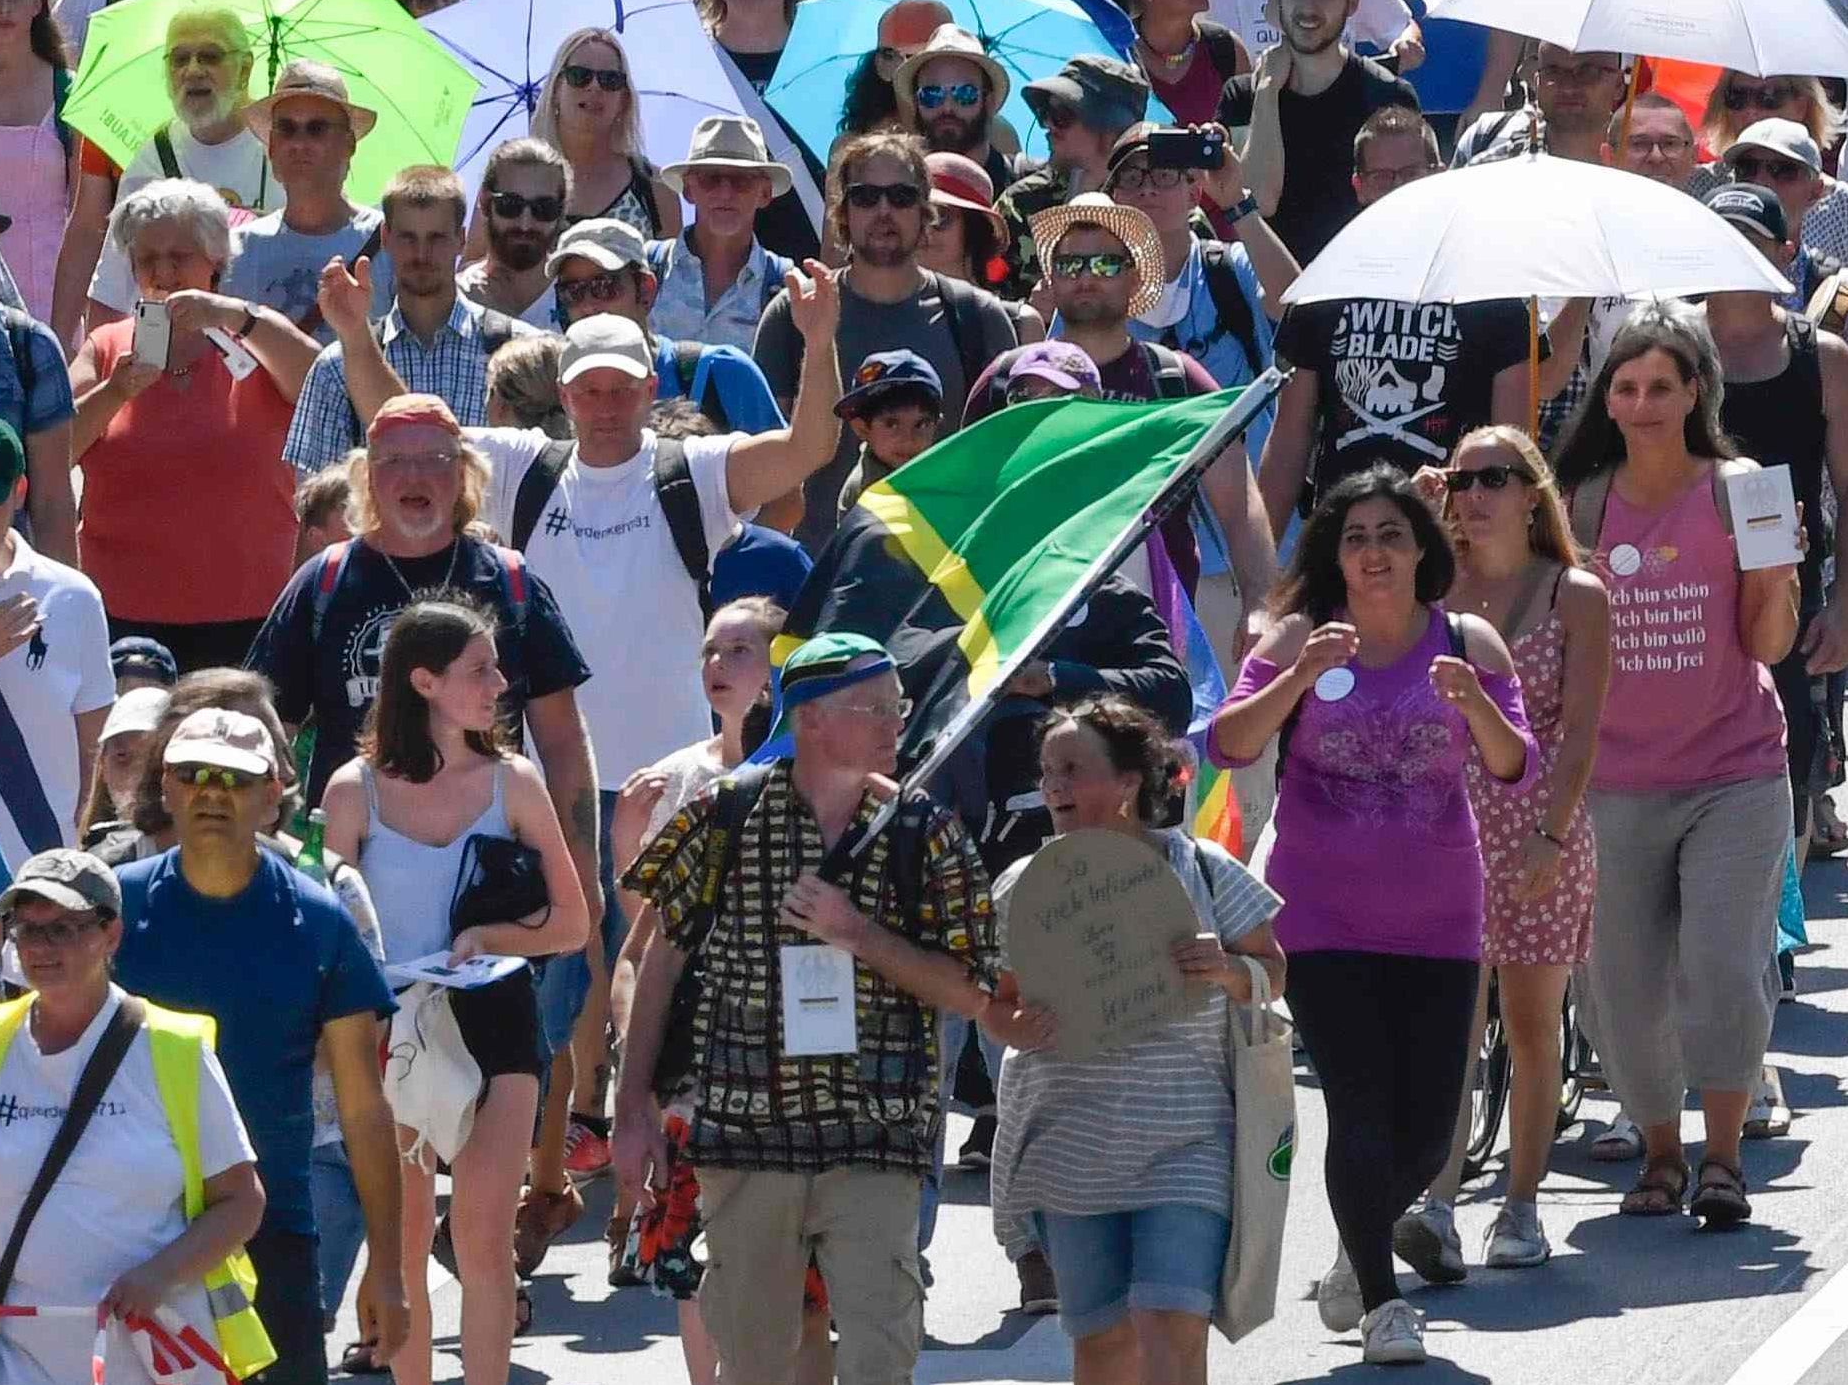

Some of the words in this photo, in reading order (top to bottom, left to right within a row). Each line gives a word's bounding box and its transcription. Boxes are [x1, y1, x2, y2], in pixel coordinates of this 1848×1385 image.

[1347, 332, 1436, 362] BLADE
[1606, 588, 1630, 605] Ich
[1634, 587, 1660, 604] bin
[1664, 581, 1709, 600] schön
[1611, 610, 1640, 628] Ich
[1645, 608, 1670, 624] bin
[1611, 632, 1640, 650] Ich
[1643, 631, 1668, 648] bin
[1672, 626, 1706, 645] wild
[1617, 655, 1643, 671] Ich
[1646, 653, 1672, 670] bin
[1672, 651, 1704, 673] frei
